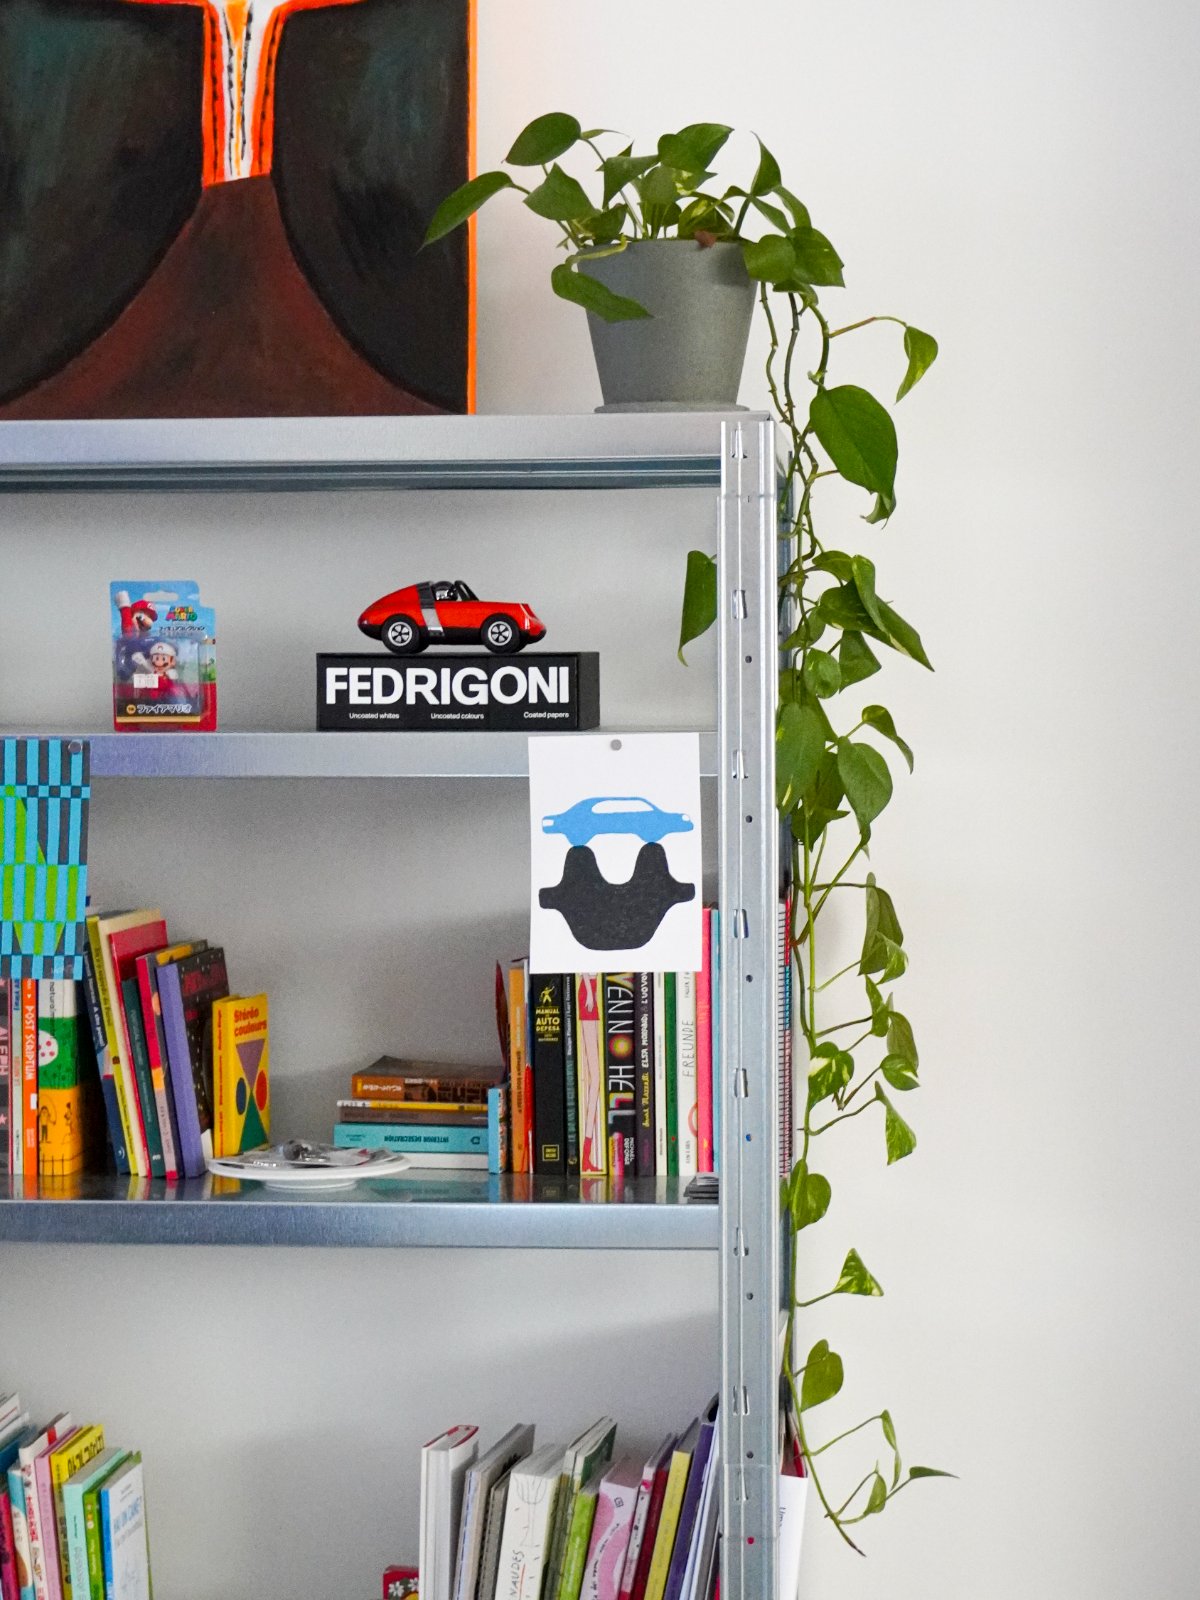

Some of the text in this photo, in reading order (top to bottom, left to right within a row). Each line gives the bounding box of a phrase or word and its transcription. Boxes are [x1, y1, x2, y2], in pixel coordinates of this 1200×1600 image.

[165, 611, 197, 621] MARIO
[325, 665, 570, 706] FEDRIGONI
[547, 712, 570, 720] papers
[536, 1017, 560, 1025] AUTO
[24, 1005, 34, 1080] POST SCRIPTUM
[682, 1020, 695, 1078] FREUNDE
[608, 1065, 634, 1124] HELL
[384, 1134, 449, 1143] INTERIOR DESECRATION
